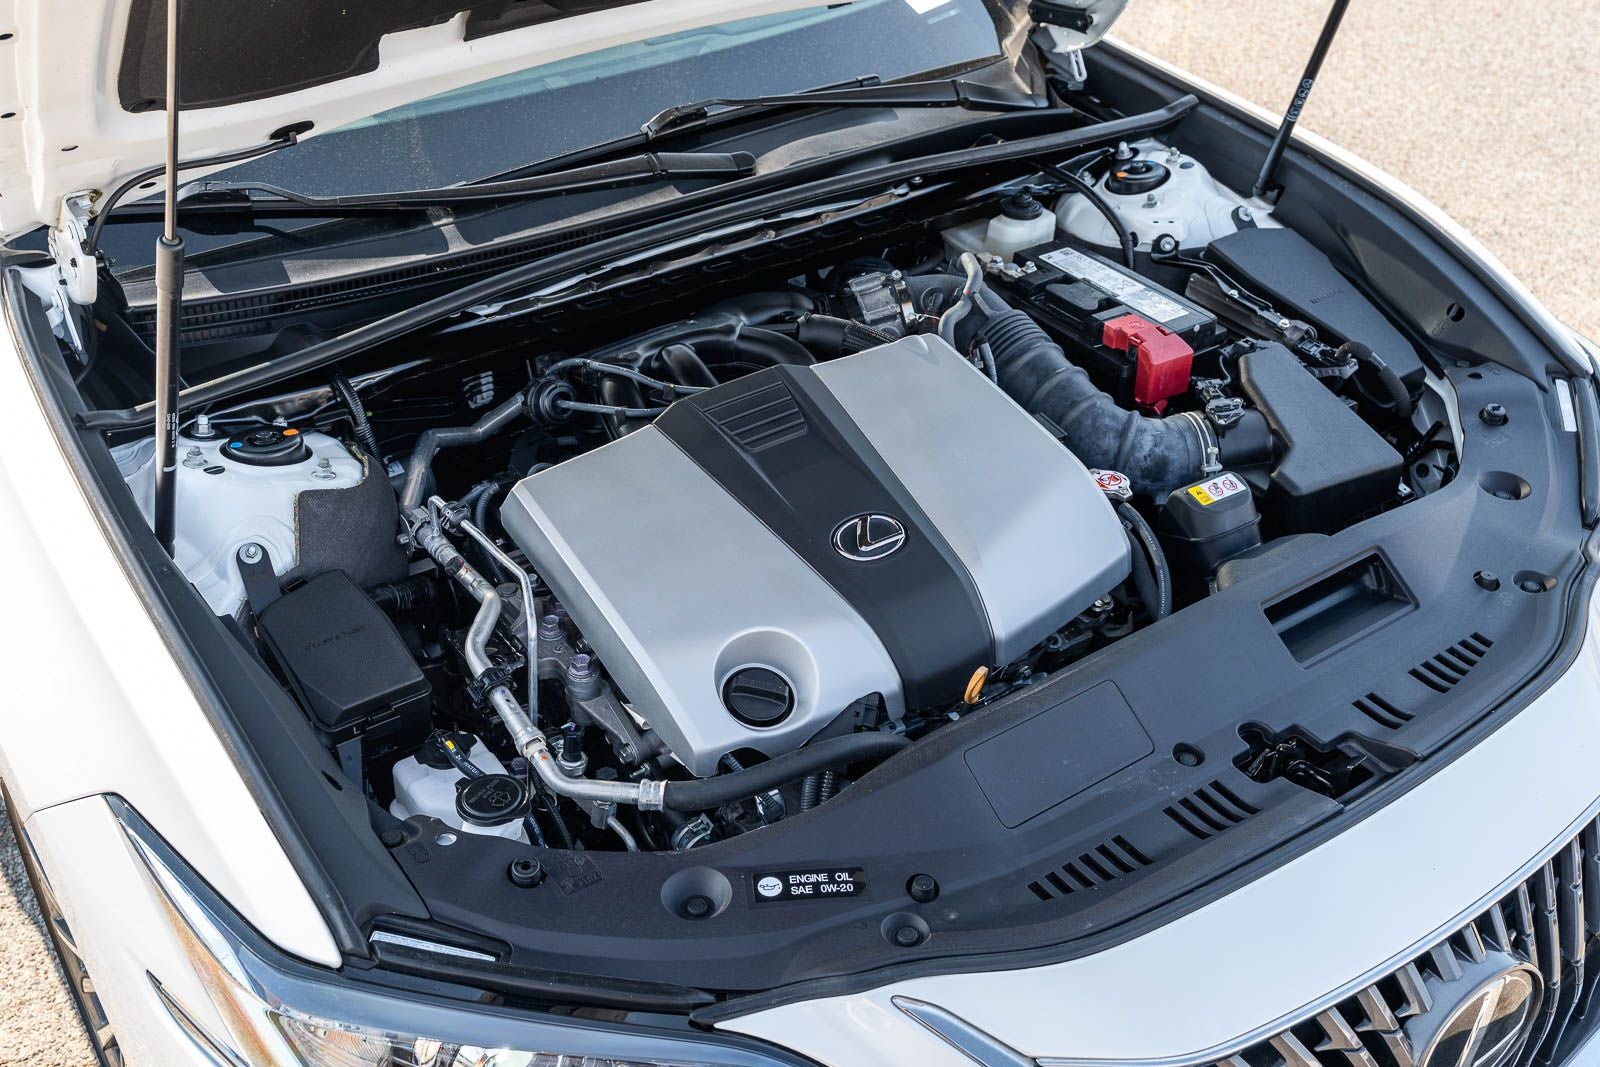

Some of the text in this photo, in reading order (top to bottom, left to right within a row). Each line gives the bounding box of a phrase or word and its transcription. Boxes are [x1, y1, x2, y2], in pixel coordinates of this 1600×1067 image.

[789, 872, 853, 884] ENGINE OIL
[790, 883, 854, 895] SAE 0W-20
